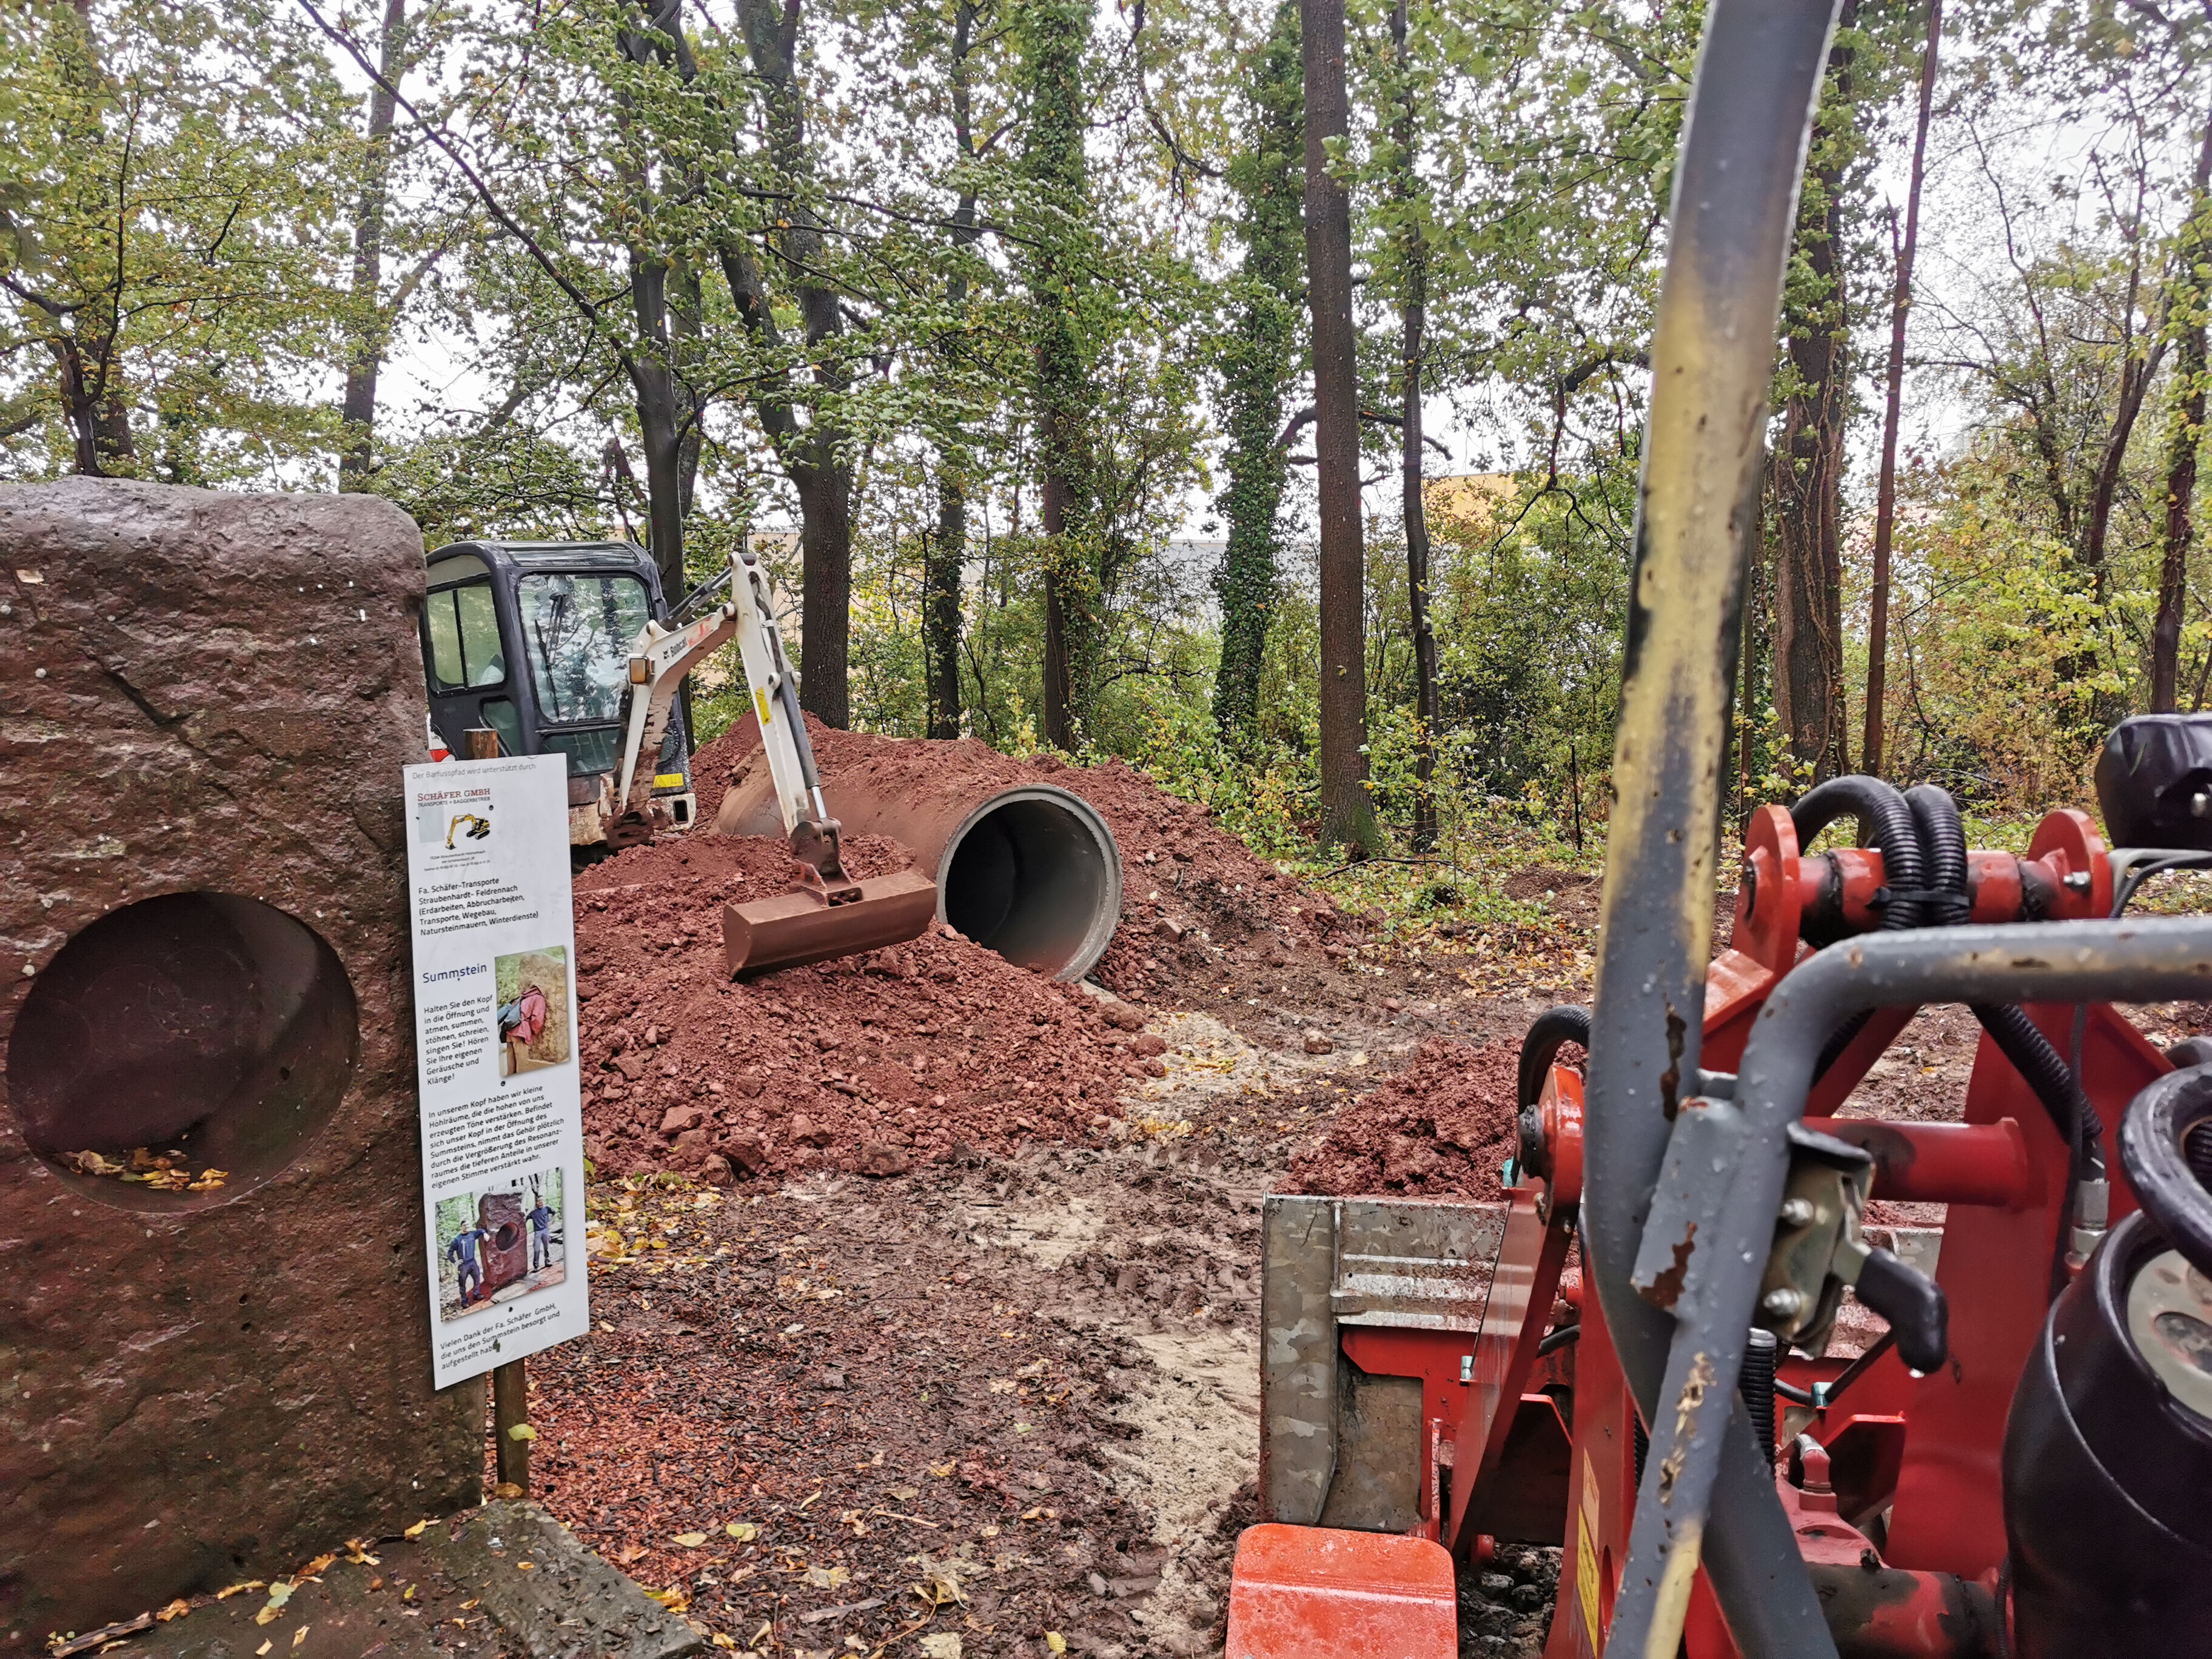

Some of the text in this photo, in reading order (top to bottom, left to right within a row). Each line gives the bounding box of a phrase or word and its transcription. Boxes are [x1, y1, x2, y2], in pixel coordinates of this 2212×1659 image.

[426, 768, 466, 778] Barfusspfad
[482, 765, 517, 774] unterstützt
[417, 788, 491, 802] SCHÄFER GMBH
[419, 885, 518, 905] Straubenhardt- Feldrennach
[431, 878, 499, 893] Schäfer-Transporte
[419, 895, 525, 916] (Erdarbeiten, Abbrucharbeiten,
[420, 909, 497, 925] Transporte, Wegebau,
[420, 911, 538, 936] Natursteinmauern, Winterdienste)
[423, 964, 487, 984] Summstein
[424, 1005, 447, 1014] Halten
[477, 994, 492, 1004] Kopf
[446, 1008, 475, 1020] Öffnung
[425, 1017, 484, 1034] atmen, summen,
[426, 1027, 489, 1045] stöhnen, schreien,
[426, 1045, 450, 1055] singen
[468, 1036, 489, 1045] Hören
[455, 1048, 483, 1059] eigenen
[427, 1057, 479, 1075] Geräusche und
[427, 1073, 455, 1085] Klänge!
[437, 1104, 469, 1116] unserem
[471, 1098, 486, 1108] Kopf
[488, 1094, 509, 1103] haben
[523, 1085, 543, 1094] kleine
[429, 1114, 470, 1128] Hohlräume,
[496, 1102, 517, 1111] hohen
[429, 1102, 553, 1139] erzeugten Töne verstärken. Befindet
[430, 1141, 444, 1149] sich
[446, 1134, 466, 1145] unser
[468, 1128, 484, 1139] Kopf
[494, 1124, 505, 1132] der
[507, 1117, 534, 1128] Öffnung
[535, 1113, 547, 1121] des
[431, 1118, 565, 1158] Summsteins, nimmt das Gehör plötzlich
[431, 1158, 451, 1168] durch
[453, 1153, 463, 1162] die
[465, 1141, 512, 1159] Vergrößerung
[528, 1129, 563, 1142] Resonanz-
[432, 1168, 458, 1178] raumes
[460, 1162, 471, 1171] die
[472, 1155, 499, 1168] tieferen
[501, 1148, 525, 1159] Anteile
[534, 1139, 558, 1150] unserer
[432, 1153, 541, 1189] eigenen Stimme verstärkt wahr.
[440, 1338, 462, 1349] Vielen
[463, 1330, 481, 1341] Dank
[483, 1326, 494, 1335] der
[507, 1312, 531, 1326] Schäfer
[535, 1303, 556, 1315] GmbH,
[468, 1341, 481, 1350] den
[482, 1326, 520, 1344] Summstein
[521, 1316, 546, 1329] besorgt
[548, 1310, 560, 1321] und
[441, 1352, 478, 1369] aufgestellt
